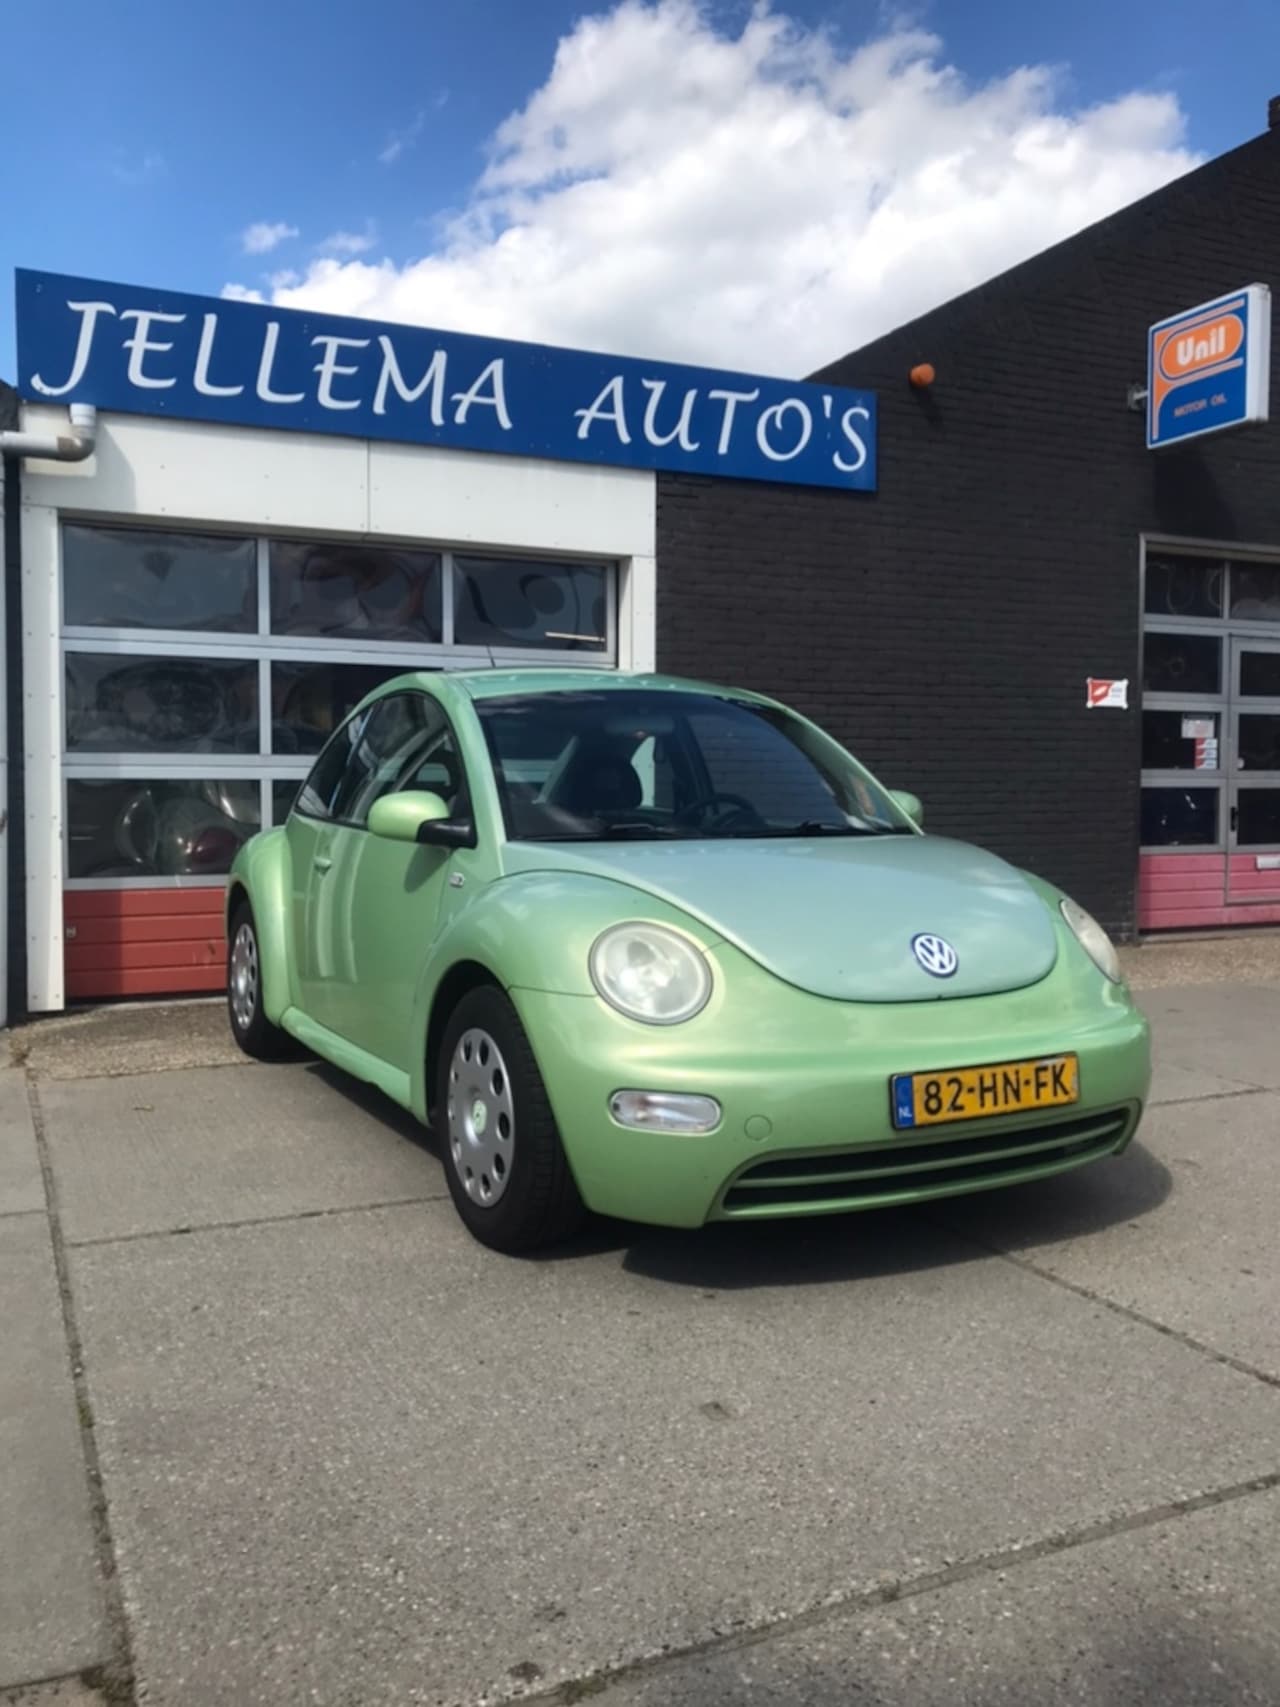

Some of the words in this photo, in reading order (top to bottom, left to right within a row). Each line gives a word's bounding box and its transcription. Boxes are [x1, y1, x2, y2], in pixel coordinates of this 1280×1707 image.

[1176, 324, 1226, 367] Unil
[30, 300, 512, 430] JELLEMA
[574, 375, 870, 472] AUTO'S
[923, 1063, 1070, 1116] 82-HN-FK
